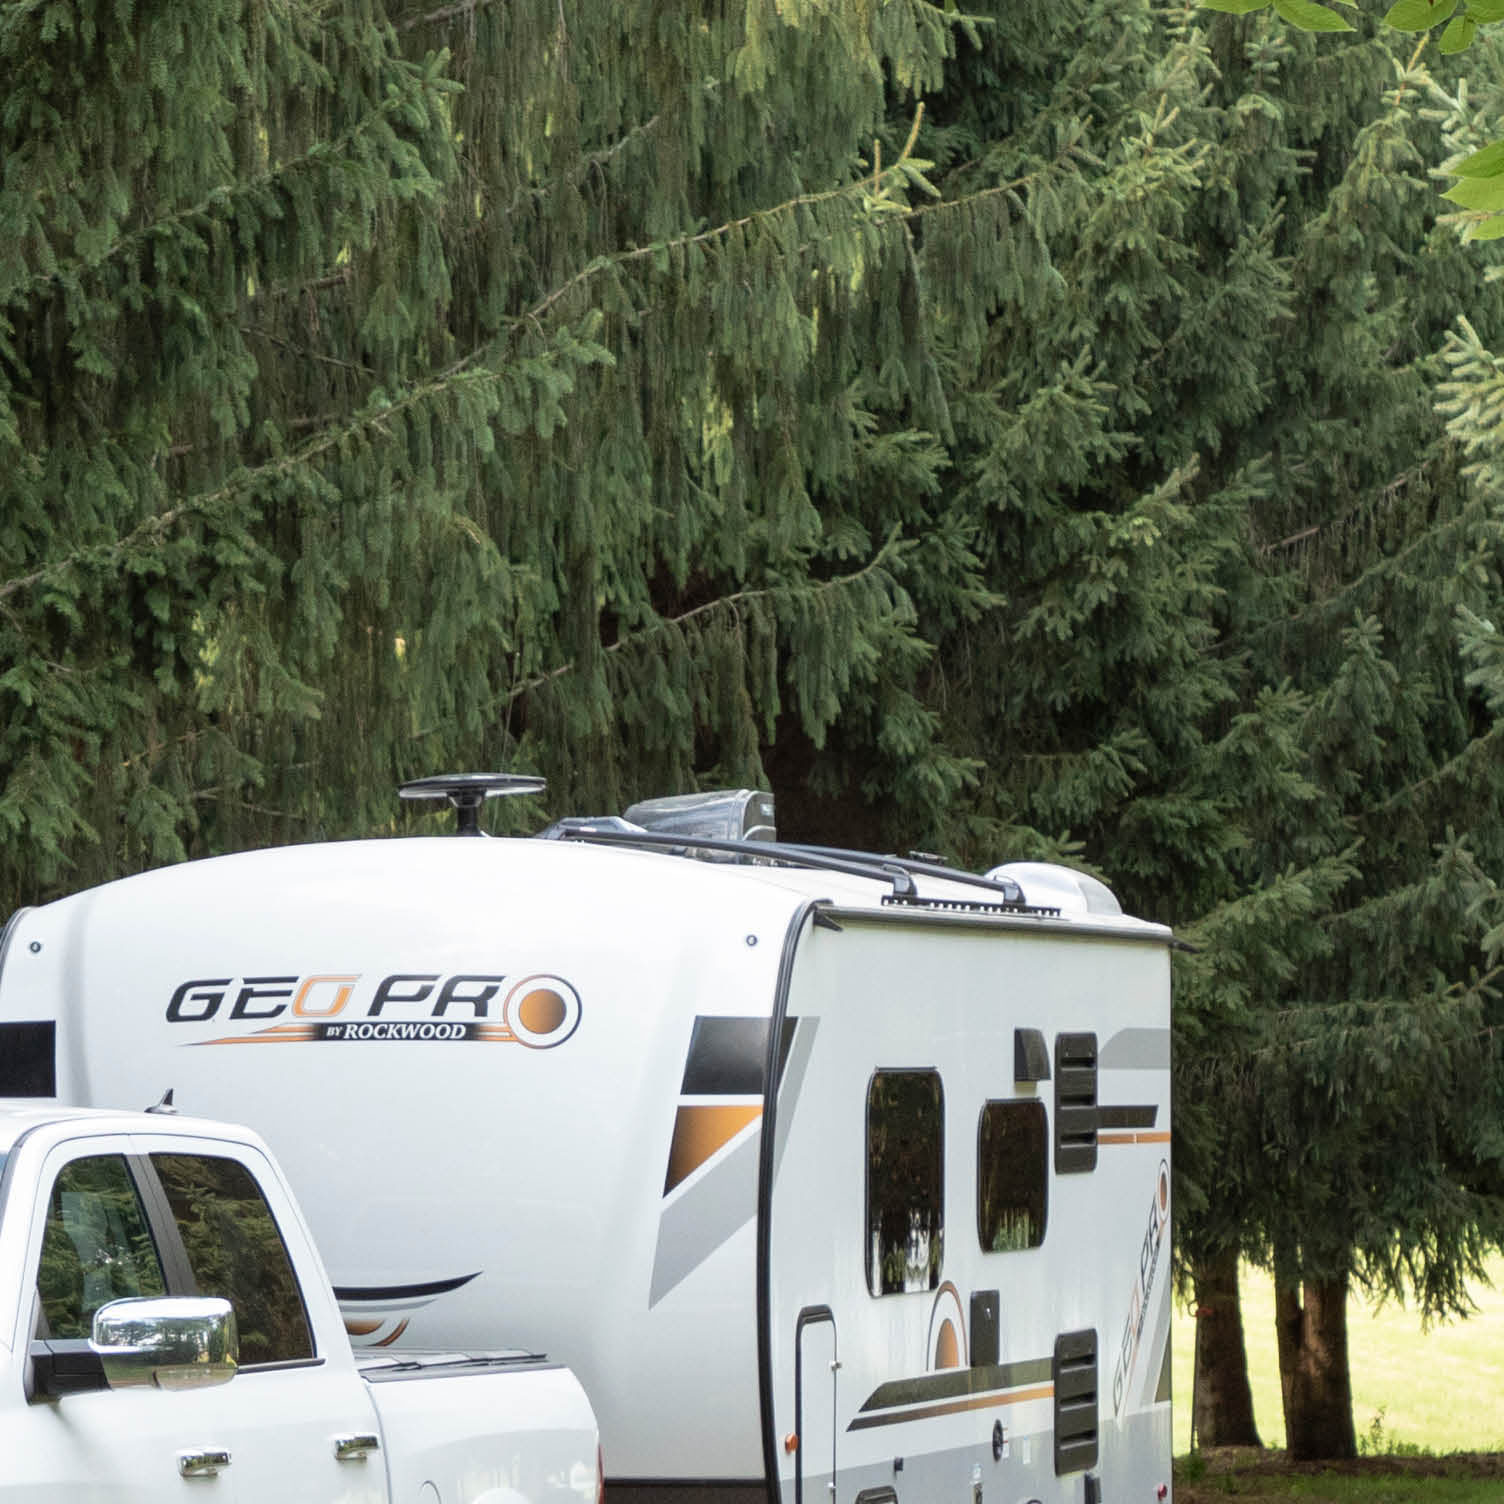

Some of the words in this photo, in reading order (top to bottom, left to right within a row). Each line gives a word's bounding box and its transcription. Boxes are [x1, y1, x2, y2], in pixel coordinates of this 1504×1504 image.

[166, 974, 362, 1023] GEO
[326, 1026, 343, 1037] BY
[343, 1023, 467, 1039] ROCKWOOD
